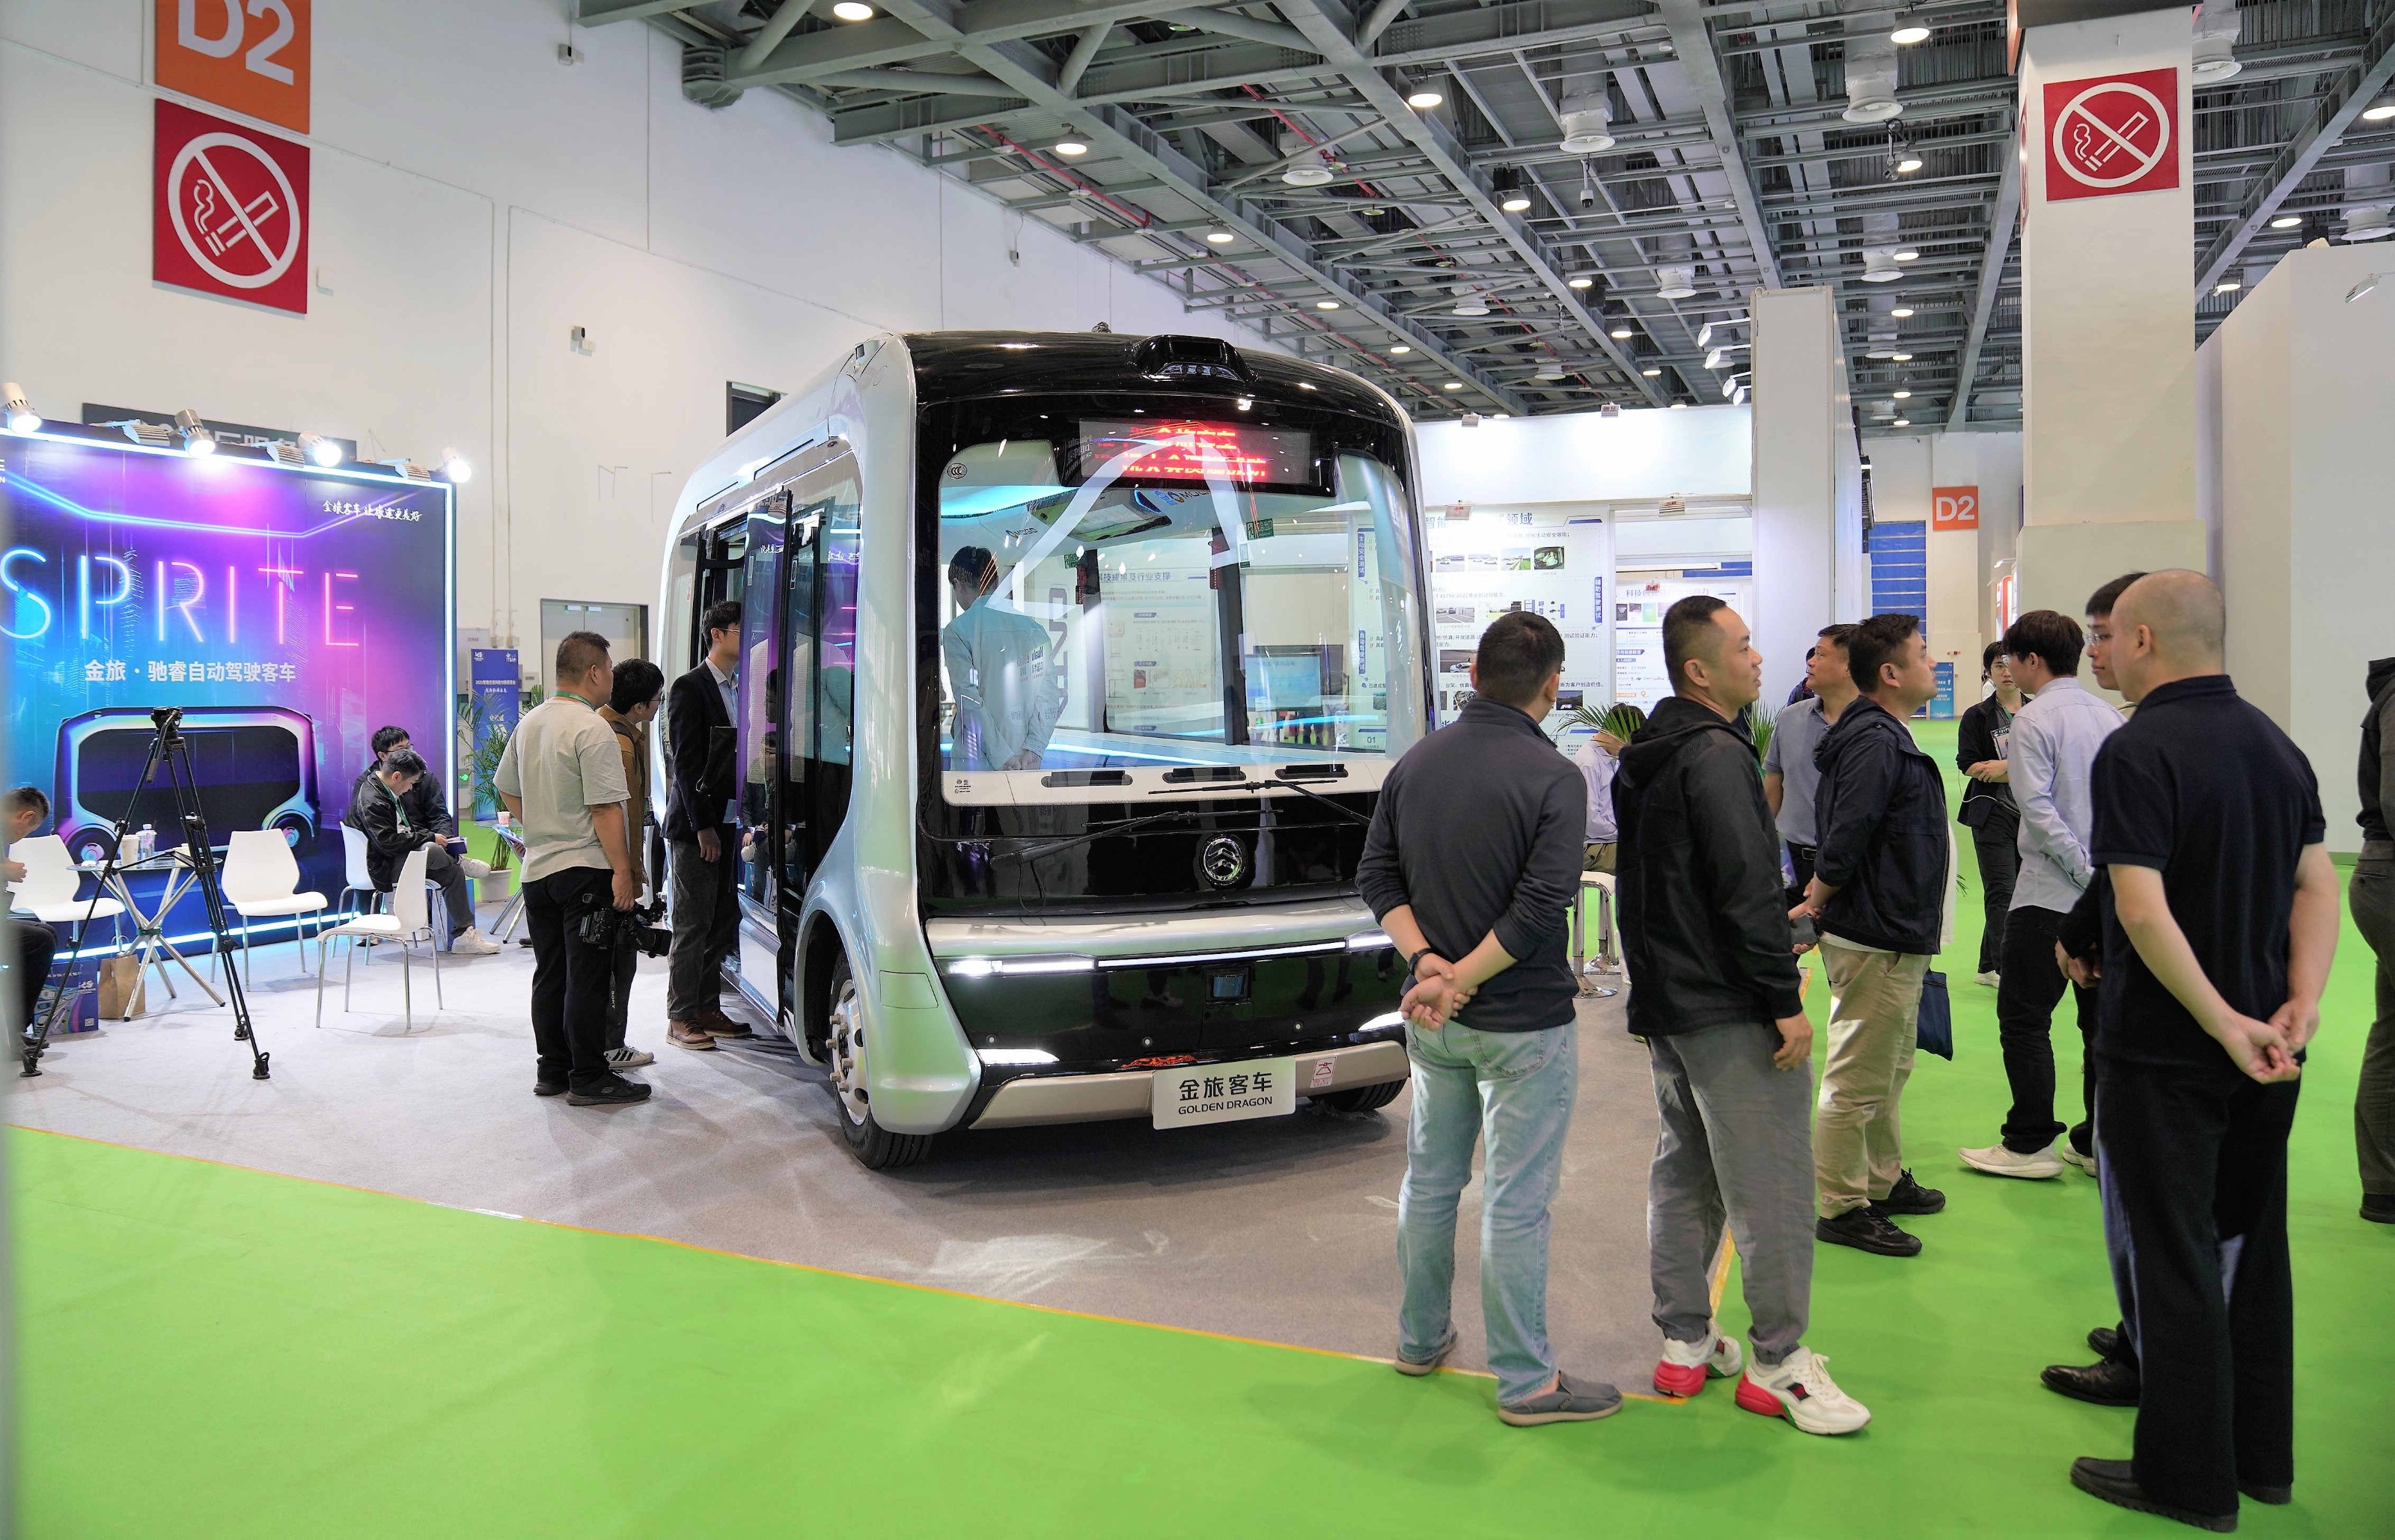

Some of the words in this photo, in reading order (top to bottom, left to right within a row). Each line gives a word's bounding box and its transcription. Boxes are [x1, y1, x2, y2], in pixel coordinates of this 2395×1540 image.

[177, 0, 295, 86] D2
[1935, 495, 1977, 522] D2
[0, 548, 360, 647] SPRITE
[1179, 1072, 1272, 1101] 金旅客车
[1178, 1102, 1224, 1115] GOLDEN
[1226, 1096, 1273, 1110] DRAGON
